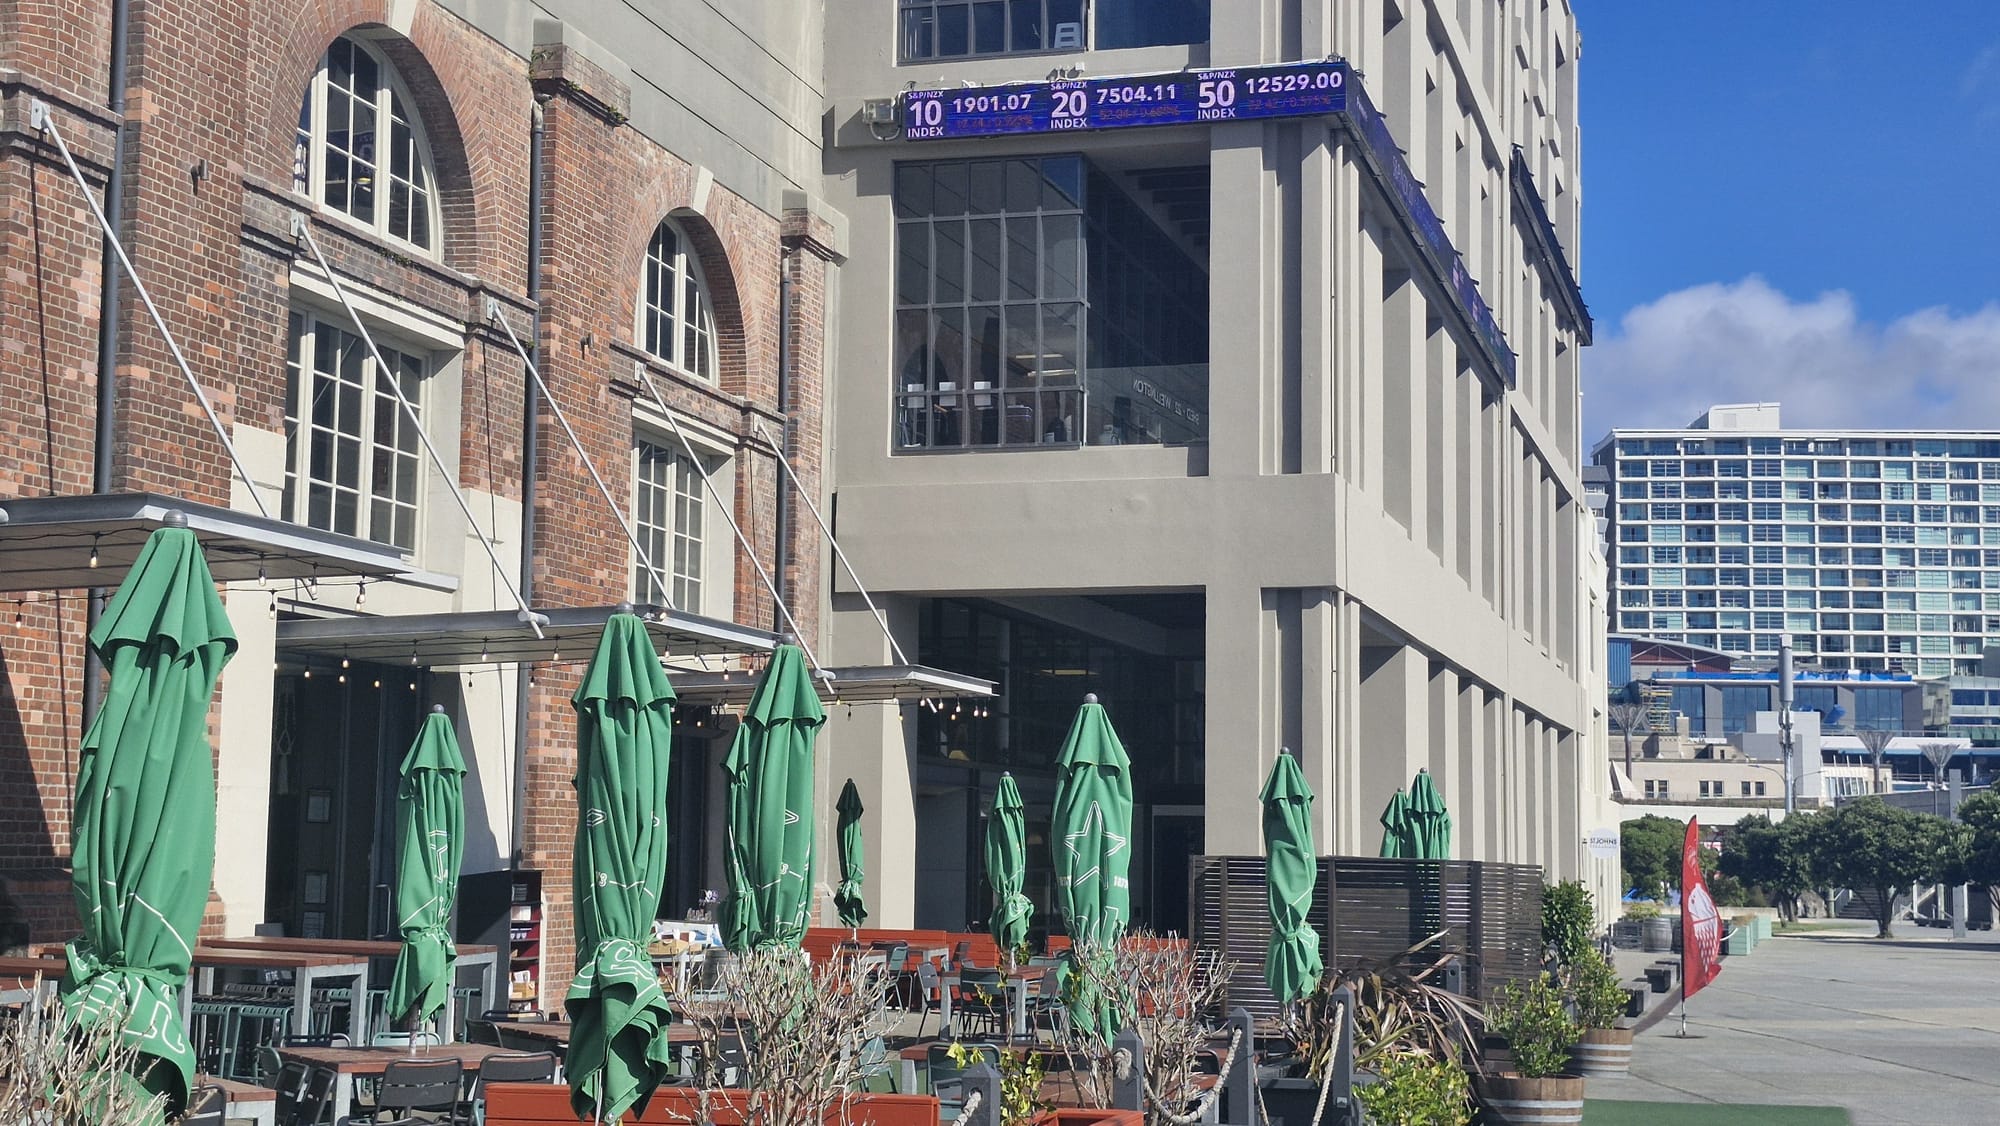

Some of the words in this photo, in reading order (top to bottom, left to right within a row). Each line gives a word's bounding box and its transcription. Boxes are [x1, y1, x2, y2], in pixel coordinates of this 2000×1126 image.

[1197, 71, 1236, 81] S&P/NZX
[1245, 71, 1343, 94] 12529.00
[1050, 81, 1088, 91] S&P/NZX
[908, 91, 944, 100] S&P/NZX
[1096, 84, 1176, 105] 7504.11
[1198, 80, 1236, 109] 50
[953, 94, 1032, 114] 1901.07
[1051, 90, 1087, 118] 20
[909, 100, 942, 127] 10
[1197, 107, 1236, 120] INDEX
[1050, 117, 1088, 129] INDEX
[907, 126, 944, 138] INDEX
